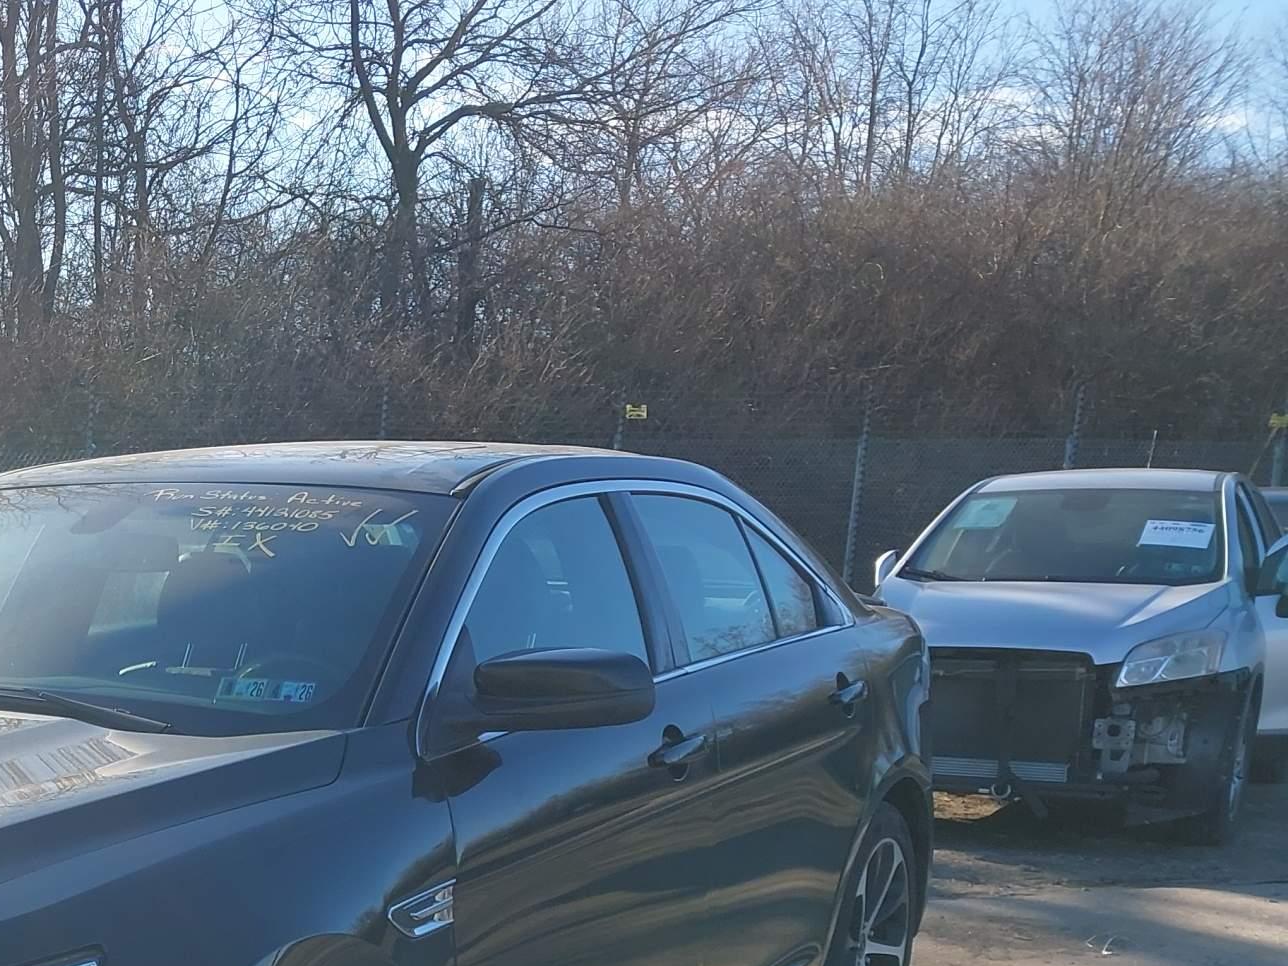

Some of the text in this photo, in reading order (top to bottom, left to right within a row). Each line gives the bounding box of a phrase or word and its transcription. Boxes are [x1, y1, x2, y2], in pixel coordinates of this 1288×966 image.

[143, 488, 194, 502] Run
[287, 491, 363, 508] Active
[250, 681, 265, 697] 26
[298, 684, 314, 701] 26
